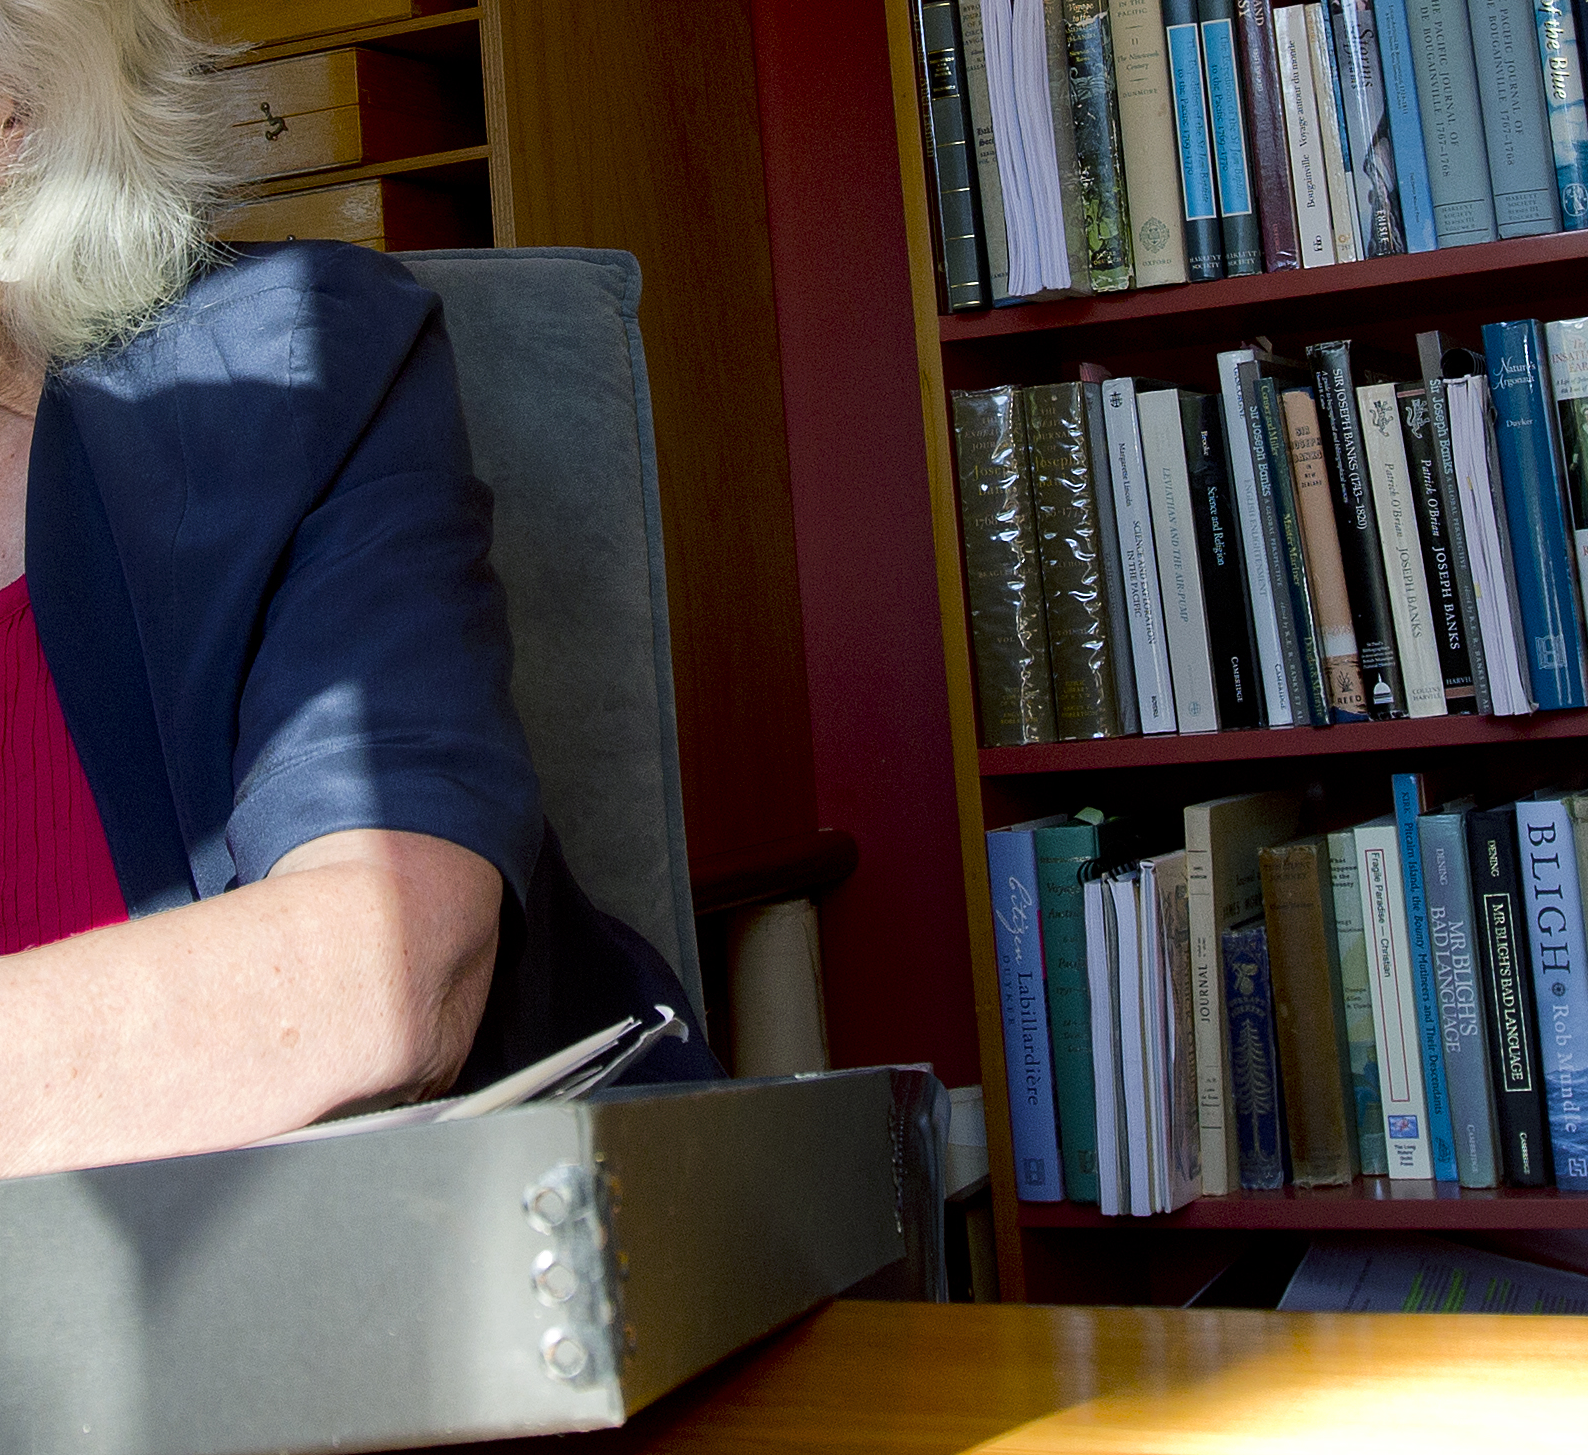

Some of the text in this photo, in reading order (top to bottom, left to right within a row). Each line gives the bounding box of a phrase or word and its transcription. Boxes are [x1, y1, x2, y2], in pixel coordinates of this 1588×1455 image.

[1544, 19, 1562, 49] the
[1550, 57, 1569, 100] Blue
[1332, 368, 1347, 387] SIR
[1335, 390, 1353, 431] JOSEPH
[1342, 432, 1359, 470] BANKS
[1370, 852, 1392, 977] Fragile Paradise Christian
[1526, 822, 1582, 1133] BLIGH Rob Mundle
